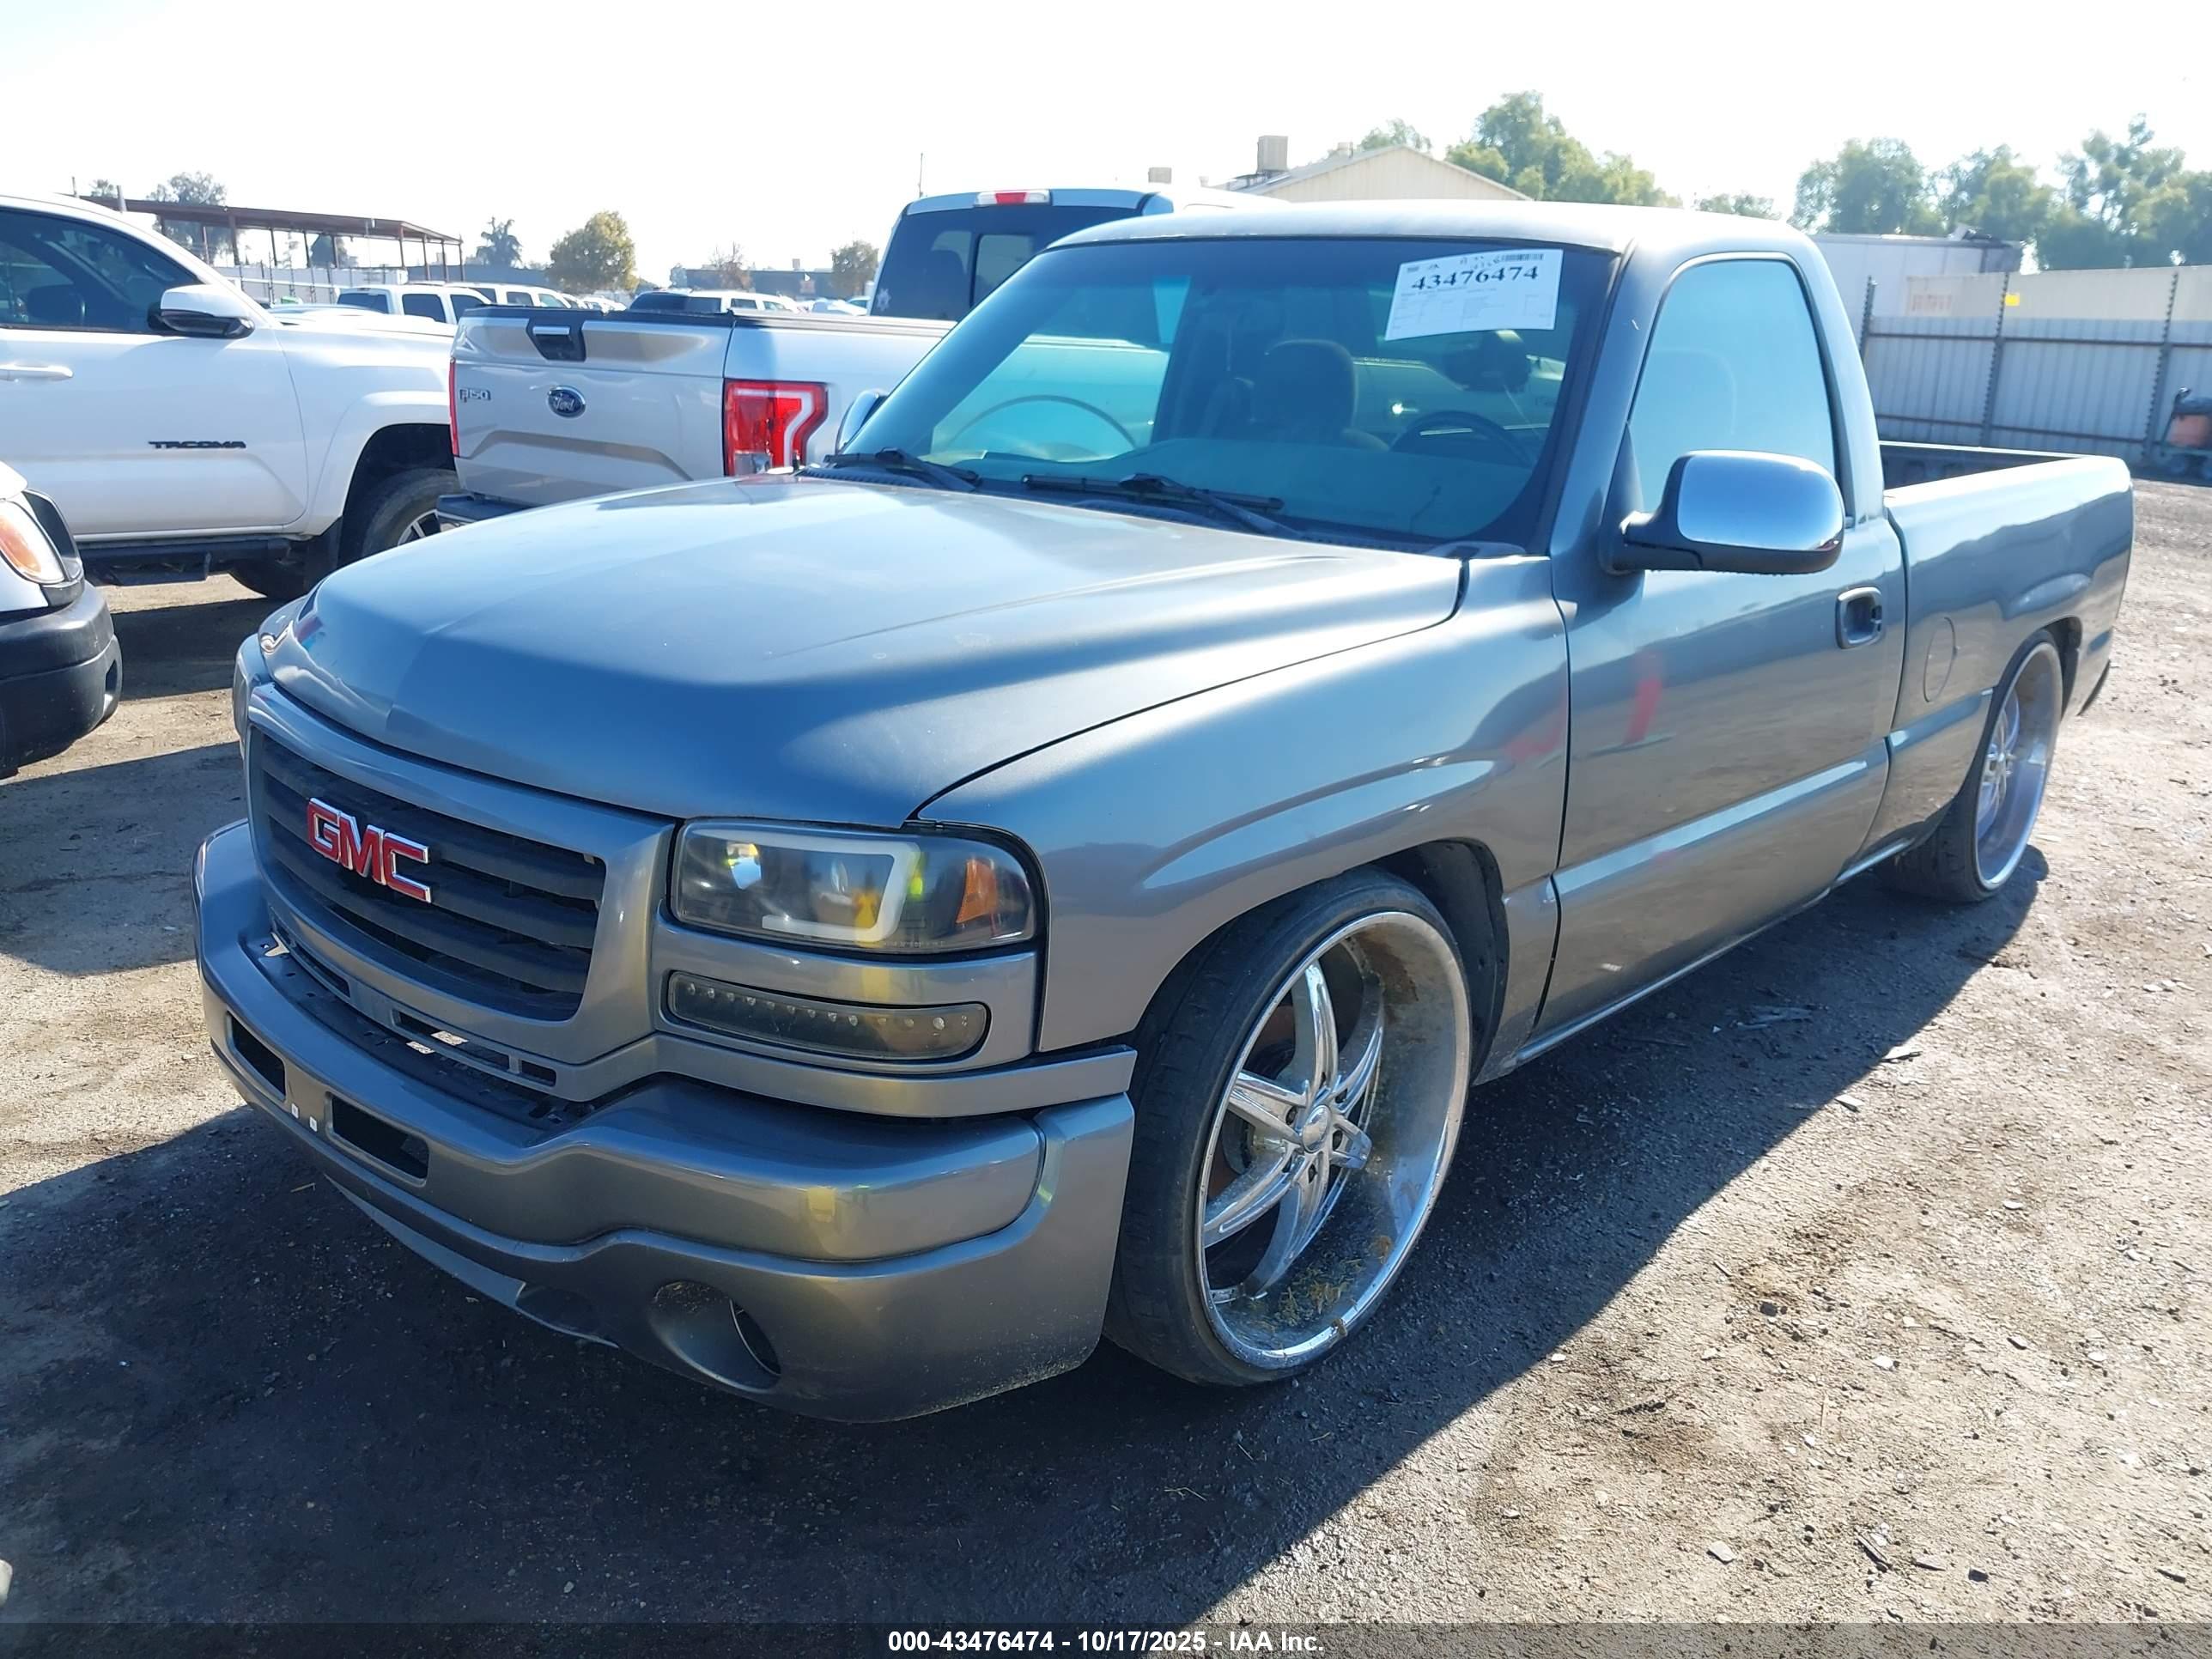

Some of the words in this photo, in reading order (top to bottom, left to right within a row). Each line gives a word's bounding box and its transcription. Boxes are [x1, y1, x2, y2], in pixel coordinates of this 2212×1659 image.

[1411, 265, 1538, 290] 43476474
[148, 441, 247, 449] TACOMA
[307, 797, 431, 903] GMC
